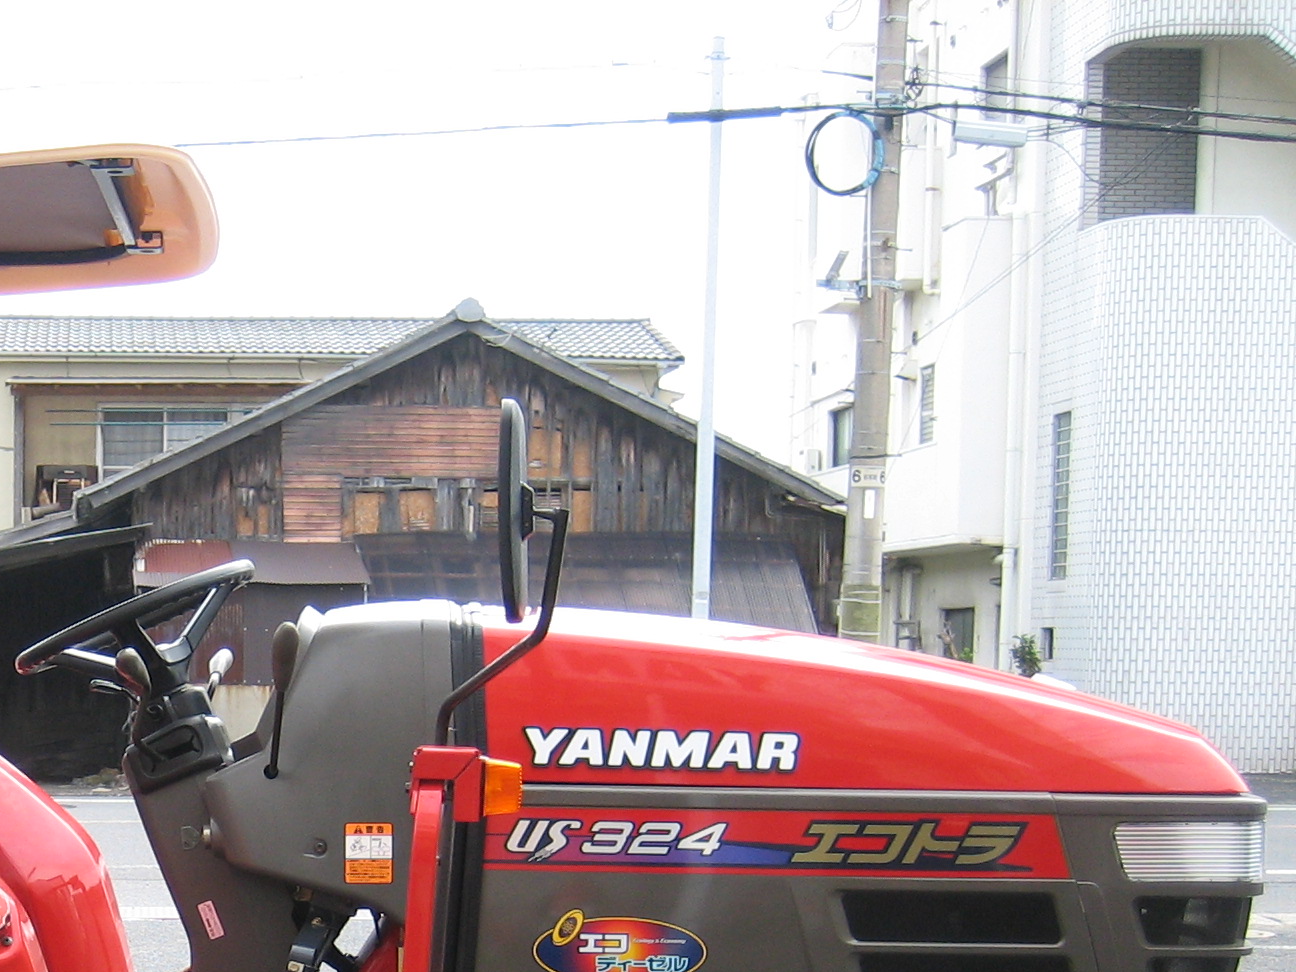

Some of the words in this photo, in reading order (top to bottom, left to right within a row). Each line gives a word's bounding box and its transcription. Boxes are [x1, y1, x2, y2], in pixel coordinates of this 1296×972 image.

[853, 470, 861, 483] 6
[524, 726, 800, 772] YANMAR
[790, 820, 1022, 866] エコトラ
[578, 933, 629, 954] エコ
